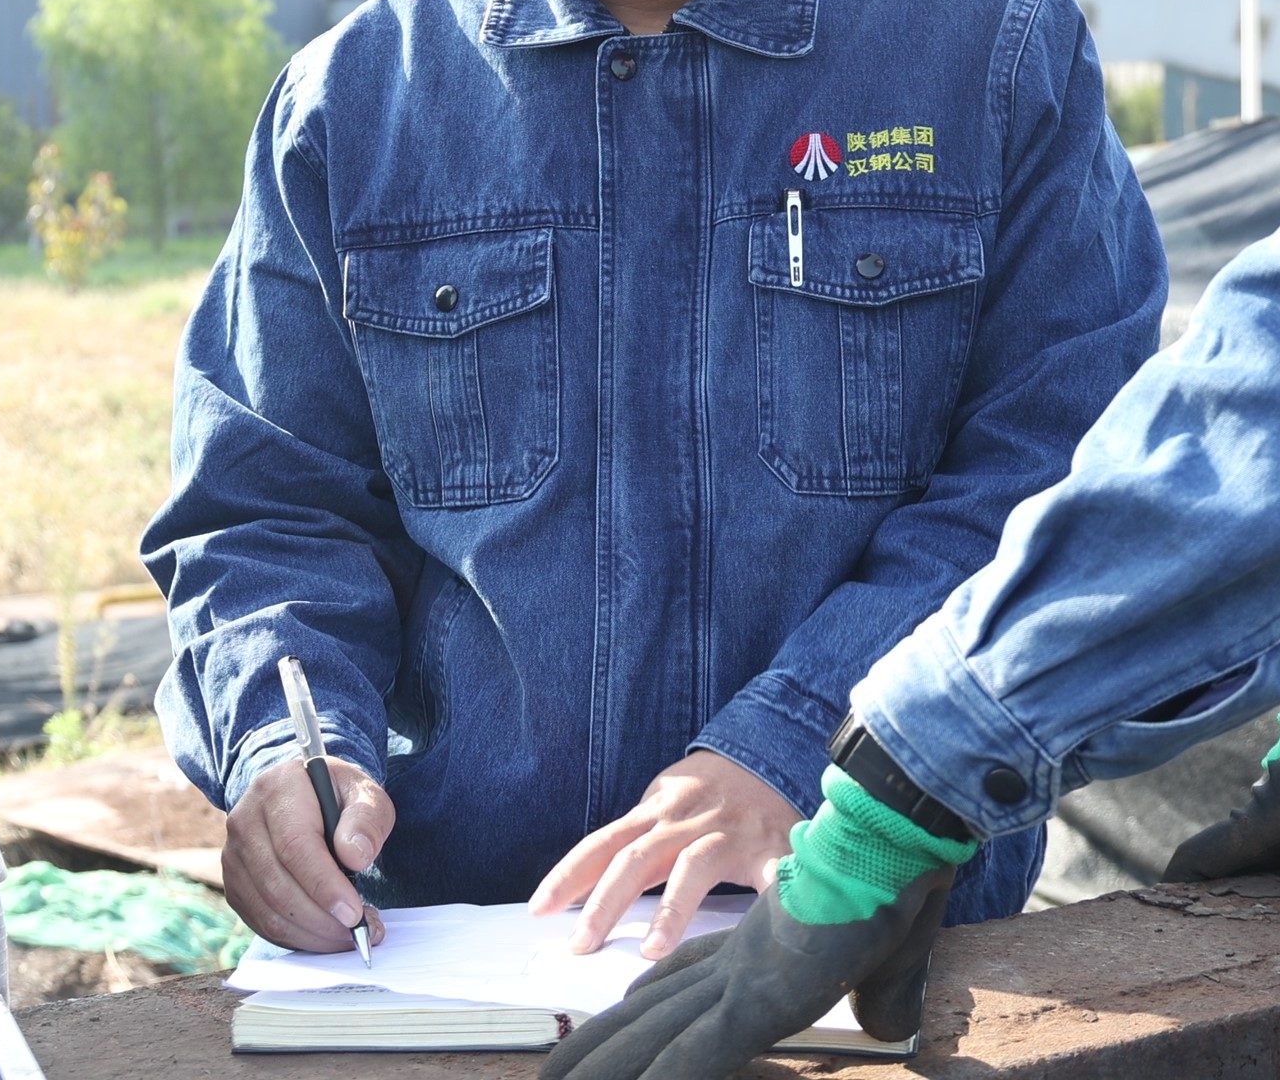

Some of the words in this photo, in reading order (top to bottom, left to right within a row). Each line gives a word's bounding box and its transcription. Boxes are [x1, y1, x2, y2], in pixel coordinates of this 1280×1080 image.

[847, 126, 934, 152] 陕钢集团
[845, 151, 934, 177] 汉钢公司
